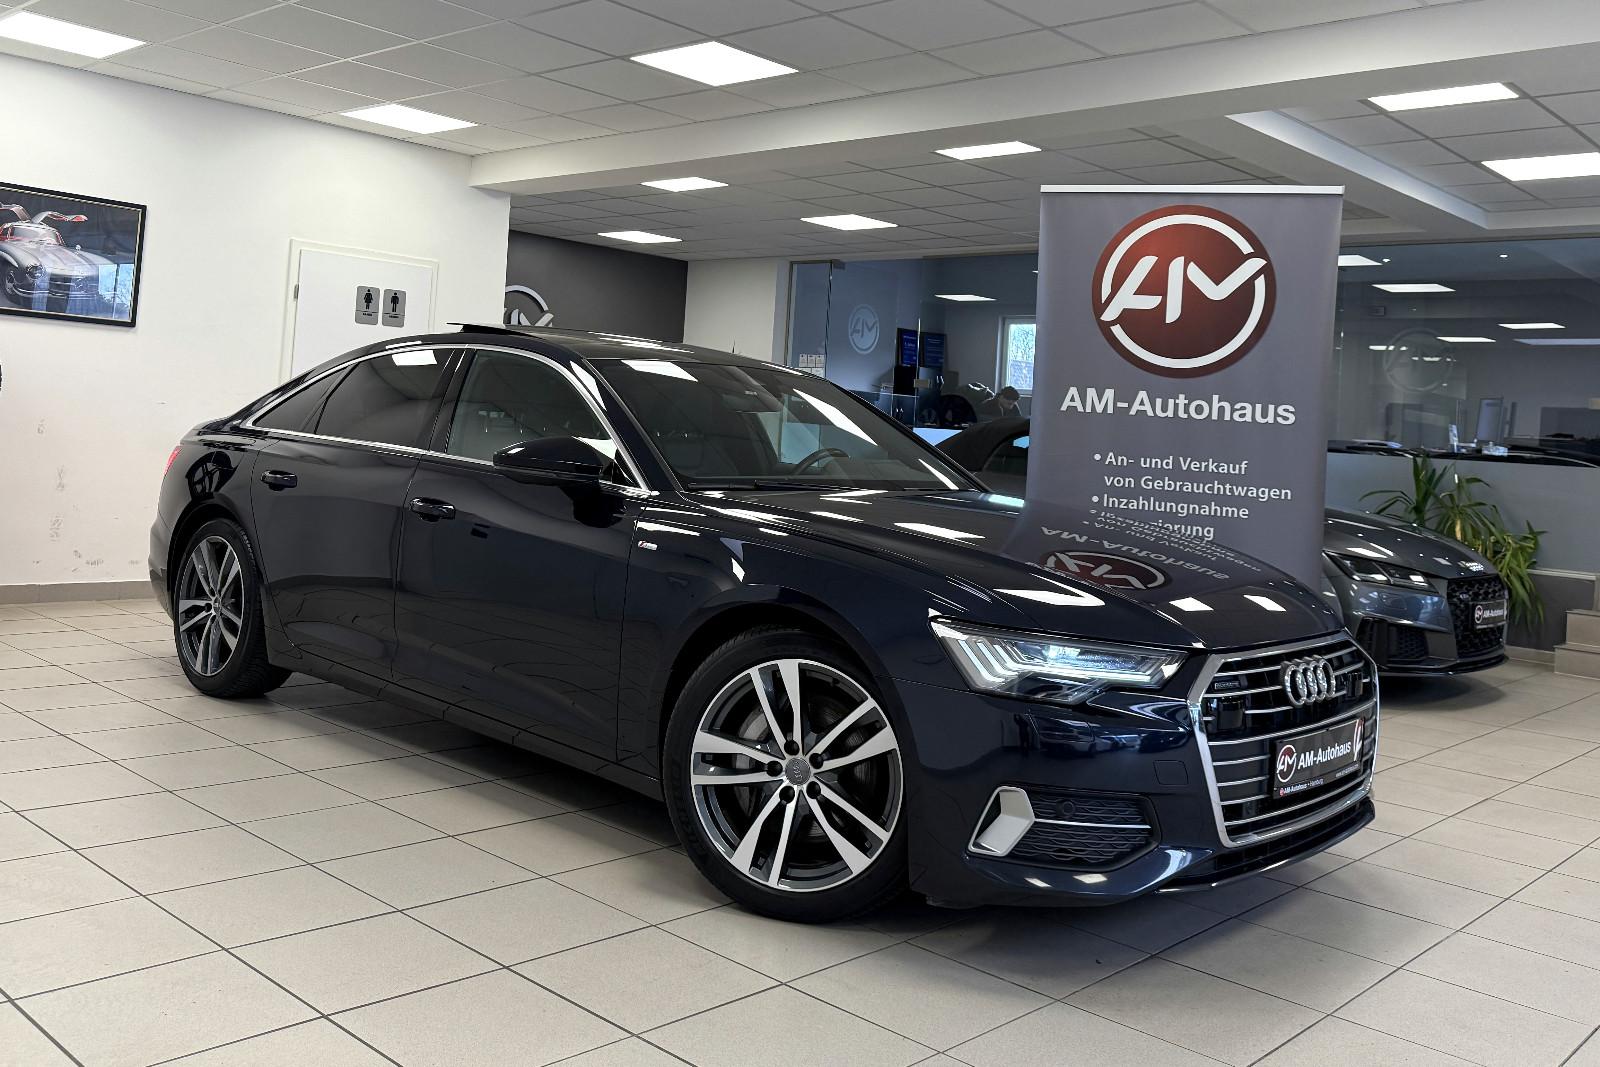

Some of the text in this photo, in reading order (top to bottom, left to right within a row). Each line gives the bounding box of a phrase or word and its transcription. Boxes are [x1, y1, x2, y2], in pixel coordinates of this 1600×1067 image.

[1060, 386, 1296, 425] AM-Autohaus
[1105, 452, 1248, 475] An- und Verkauf
[1104, 476, 1292, 502] von Gebrauchtwagen
[1103, 494, 1249, 519] Inzahlungnahme
[1298, 741, 1352, 770] AM-Autohaus
